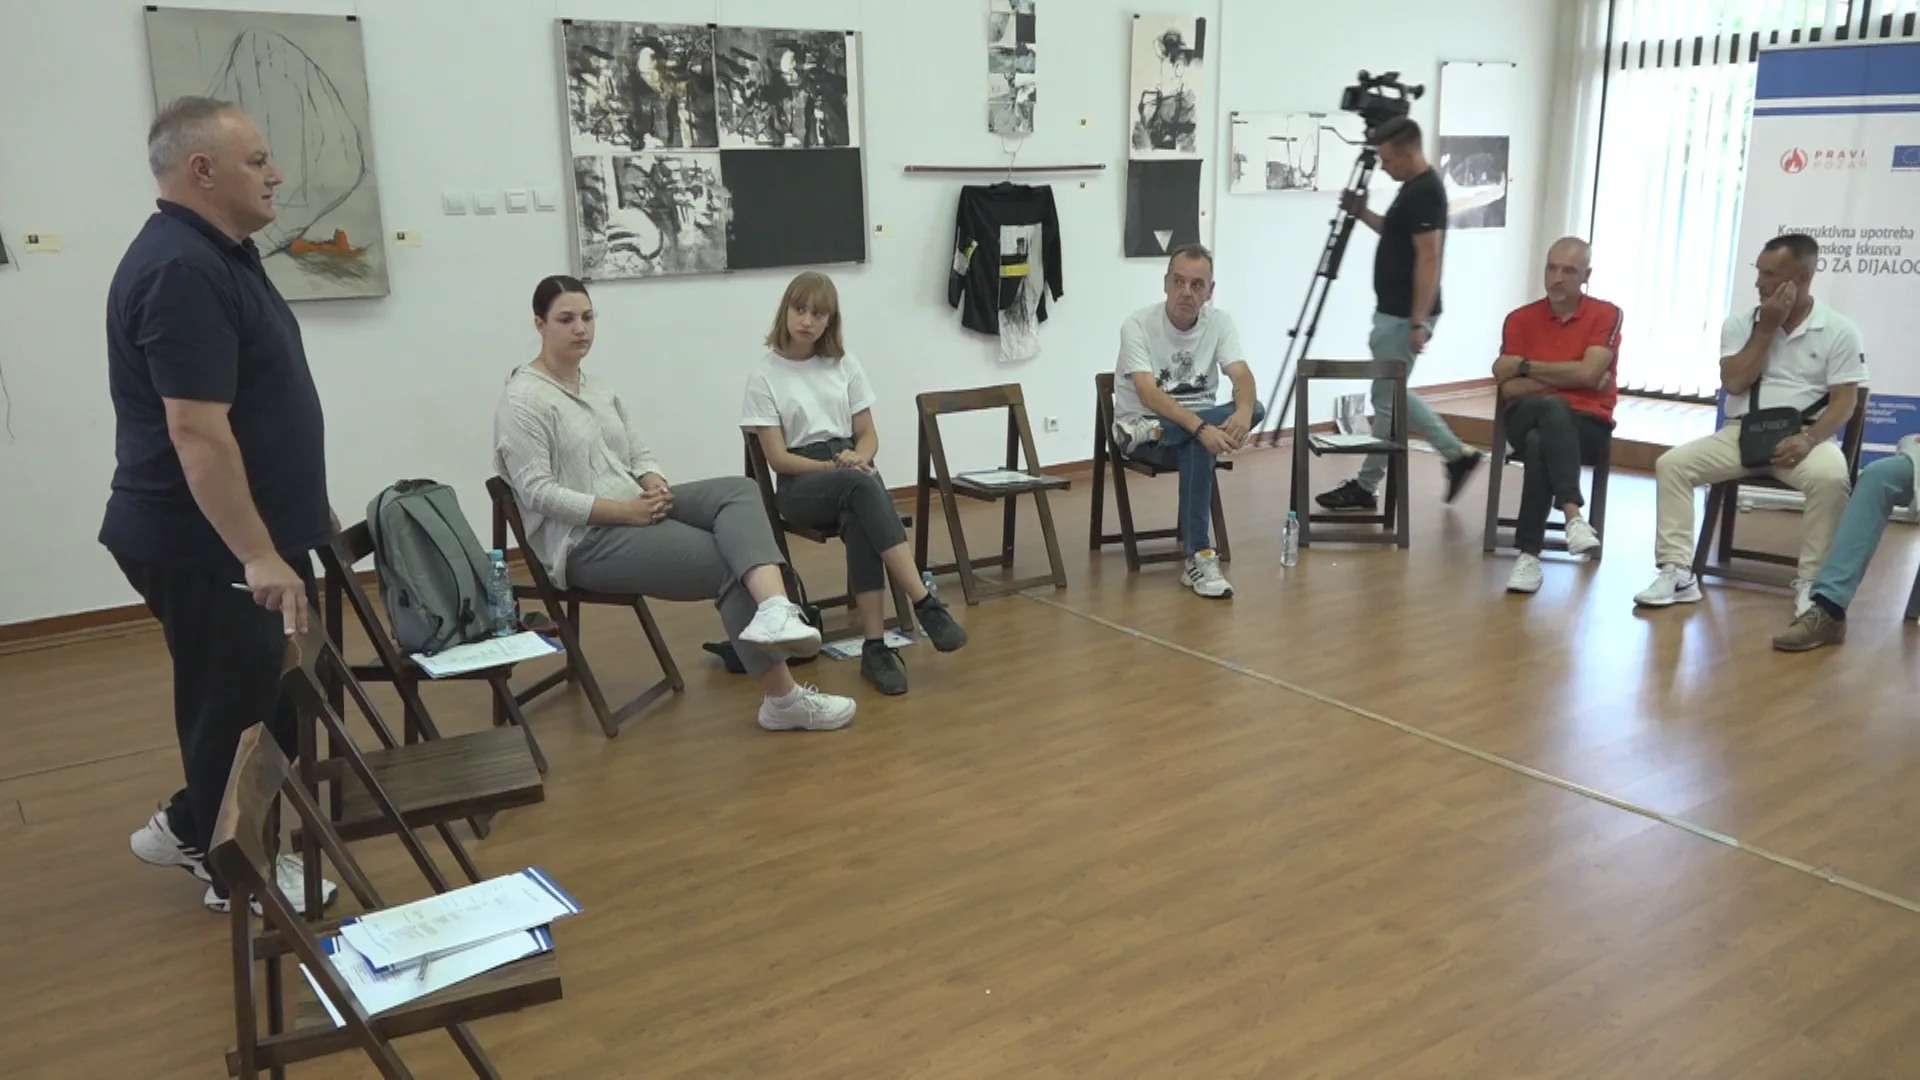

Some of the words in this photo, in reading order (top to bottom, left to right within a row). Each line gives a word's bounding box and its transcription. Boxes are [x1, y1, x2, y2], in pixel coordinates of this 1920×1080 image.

[1814, 150, 1866, 159] PRAVI
[1777, 224, 1856, 239] Konstruktivna
[1860, 225, 1914, 241] upotreba
[1819, 241, 1853, 257] nskog
[1856, 241, 1901, 256] iskustva
[1832, 257, 1853, 273] ZA
